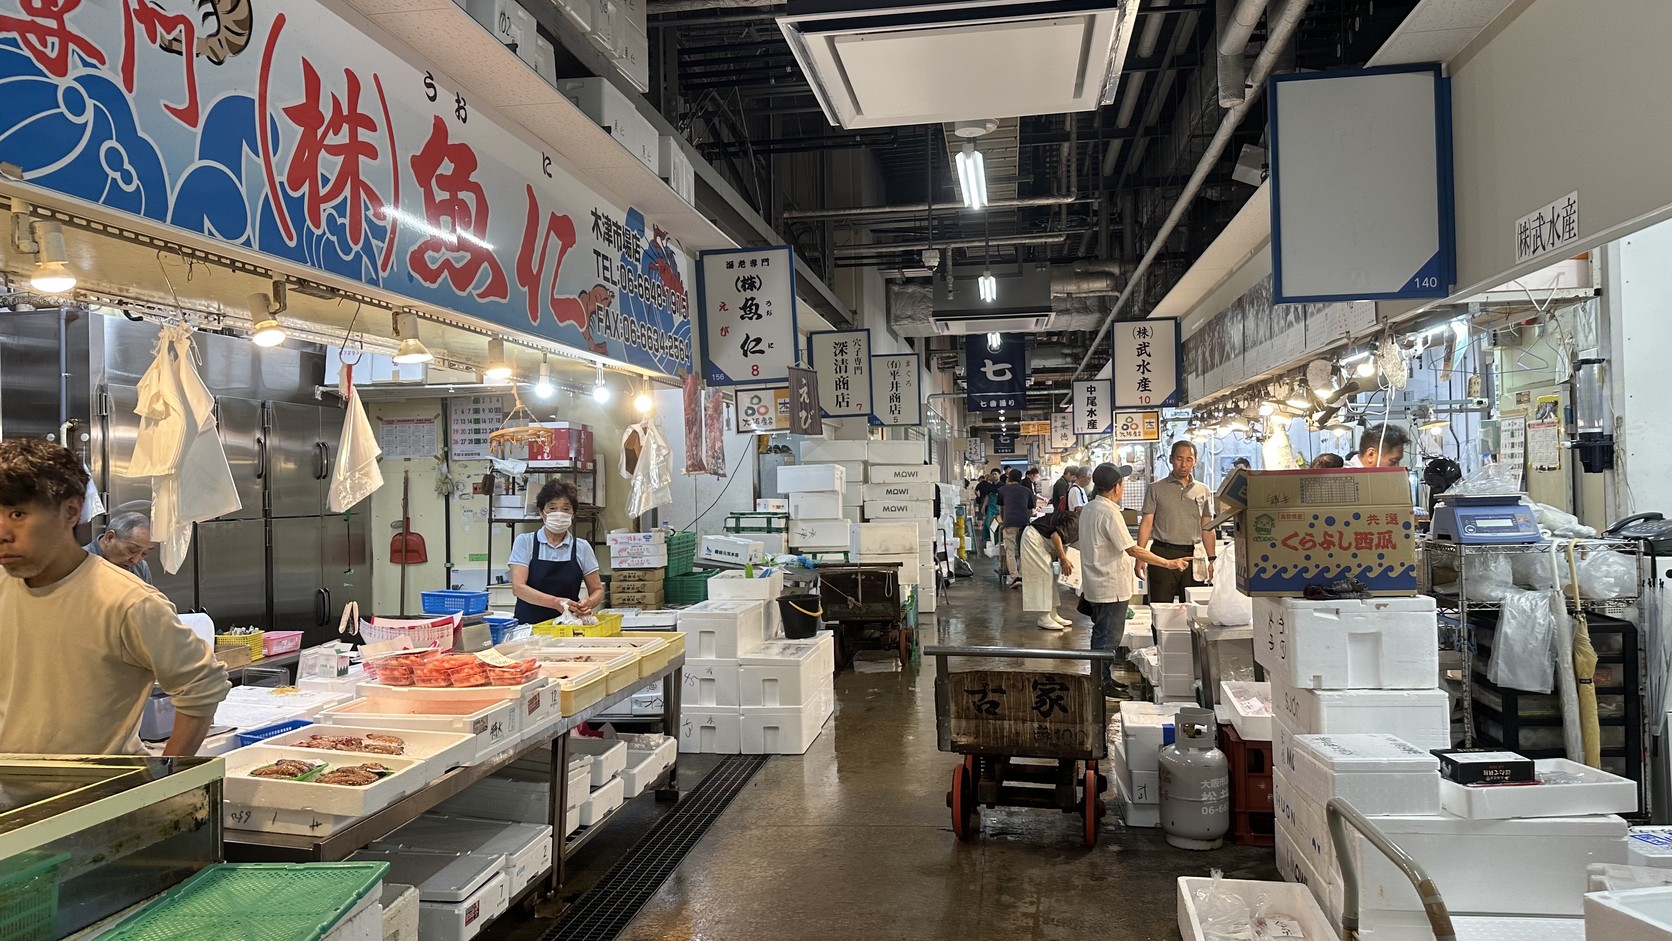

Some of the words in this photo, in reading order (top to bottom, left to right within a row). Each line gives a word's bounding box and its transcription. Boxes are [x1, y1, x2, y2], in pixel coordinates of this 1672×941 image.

[423, 70, 467, 124] うお
[541, 151, 553, 179] に
[590, 206, 642, 265] 木津市場店
[1515, 197, 1577, 258] (株)武水産
[725, 257, 770, 270] 海老専門
[1413, 276, 1438, 289] 140
[718, 301, 731, 338] えび
[751, 365, 760, 377] 8
[852, 338, 864, 376] 穴子専門
[979, 359, 1013, 382] 七
[1131, 326, 1155, 393] (株)武水産
[711, 373, 726, 382] 156
[832, 341, 851, 409] 深清商店
[904, 359, 912, 388] まぐろ
[797, 377, 815, 430] えび
[856, 403, 863, 412] 7
[1086, 384, 1098, 431] 中尾水産
[1138, 395, 1151, 405] 10
[1366, 513, 1399, 525] 共選
[1281, 529, 1397, 551] くらよし西瓜
[1201, 775, 1228, 789] 大阪市
